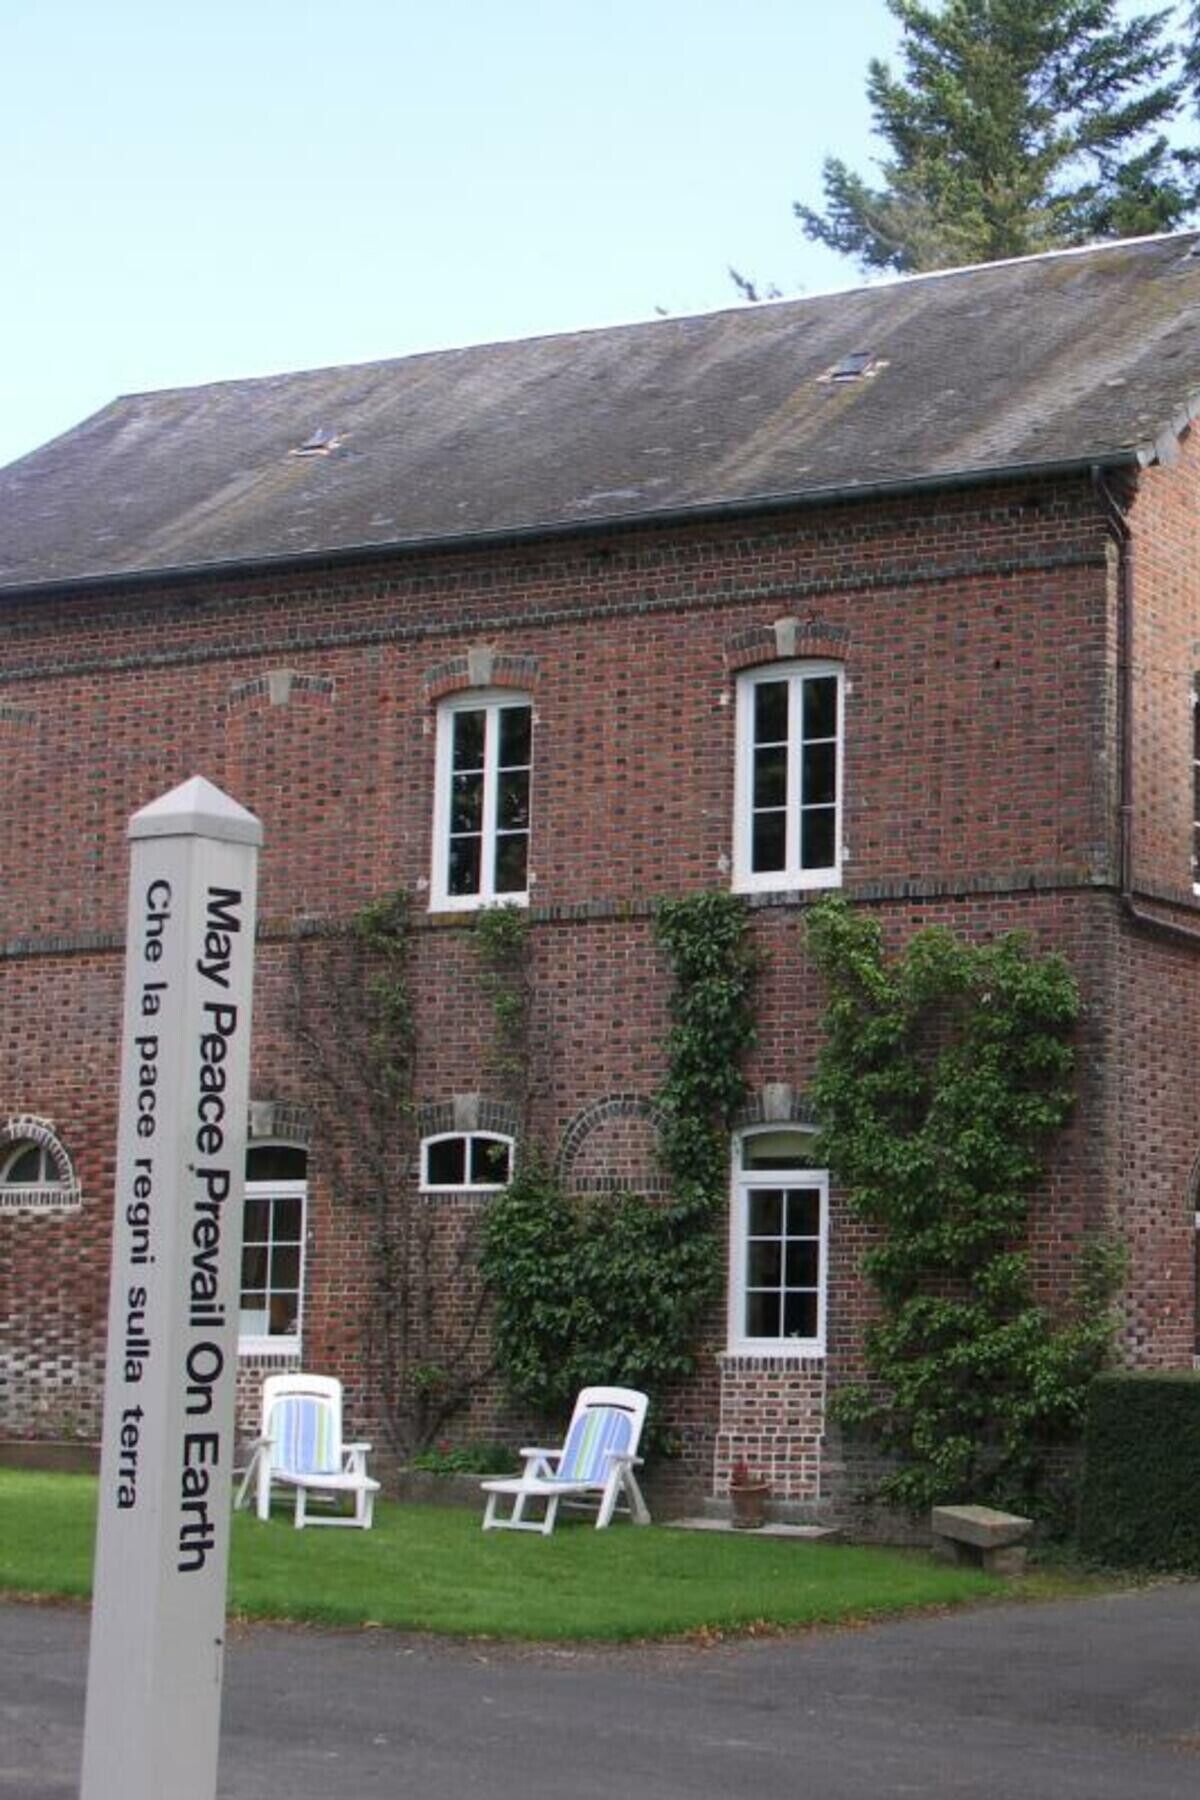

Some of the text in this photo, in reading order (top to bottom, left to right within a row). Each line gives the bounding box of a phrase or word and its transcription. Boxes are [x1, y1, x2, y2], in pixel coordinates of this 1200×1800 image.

[116, 879, 172, 1510] Che la pace regni sulla terra
[177, 886, 242, 1573] May Peace Prevail On Earth
